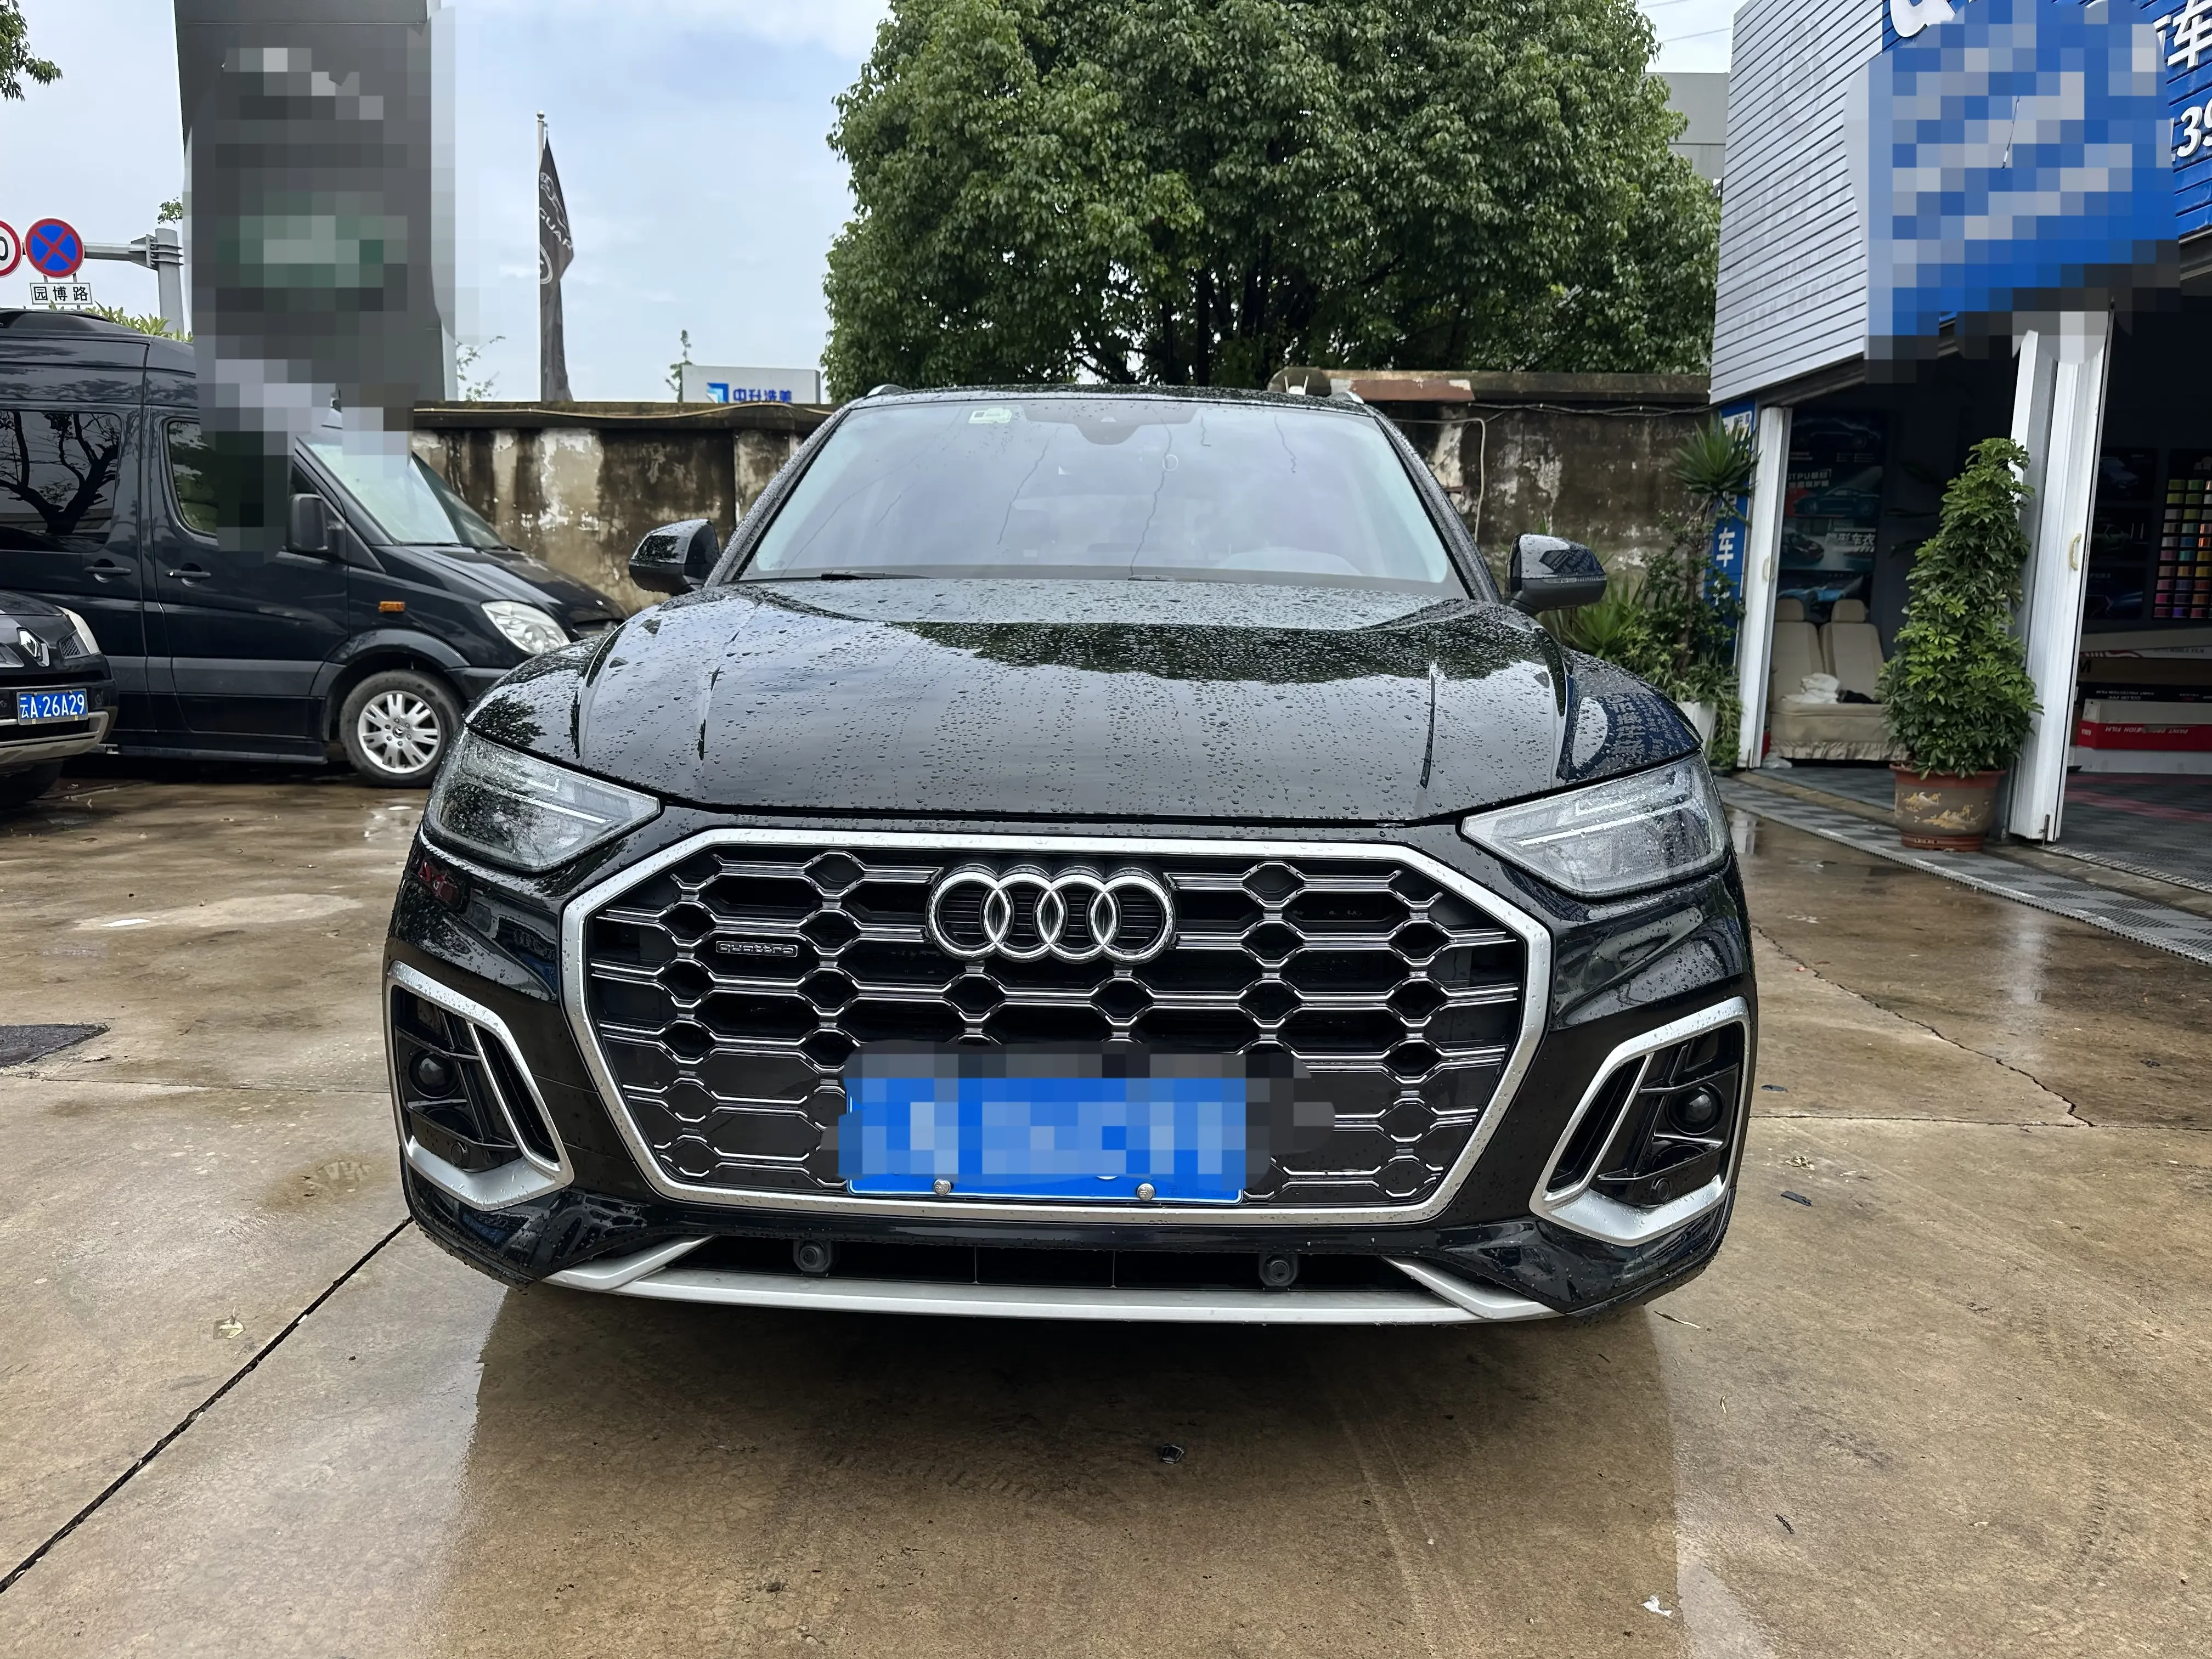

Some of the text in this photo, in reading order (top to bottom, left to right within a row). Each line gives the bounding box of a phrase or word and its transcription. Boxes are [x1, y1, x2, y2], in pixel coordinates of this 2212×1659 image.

[33, 286, 88, 301] 园博路
[719, 943, 794, 954] quattro
